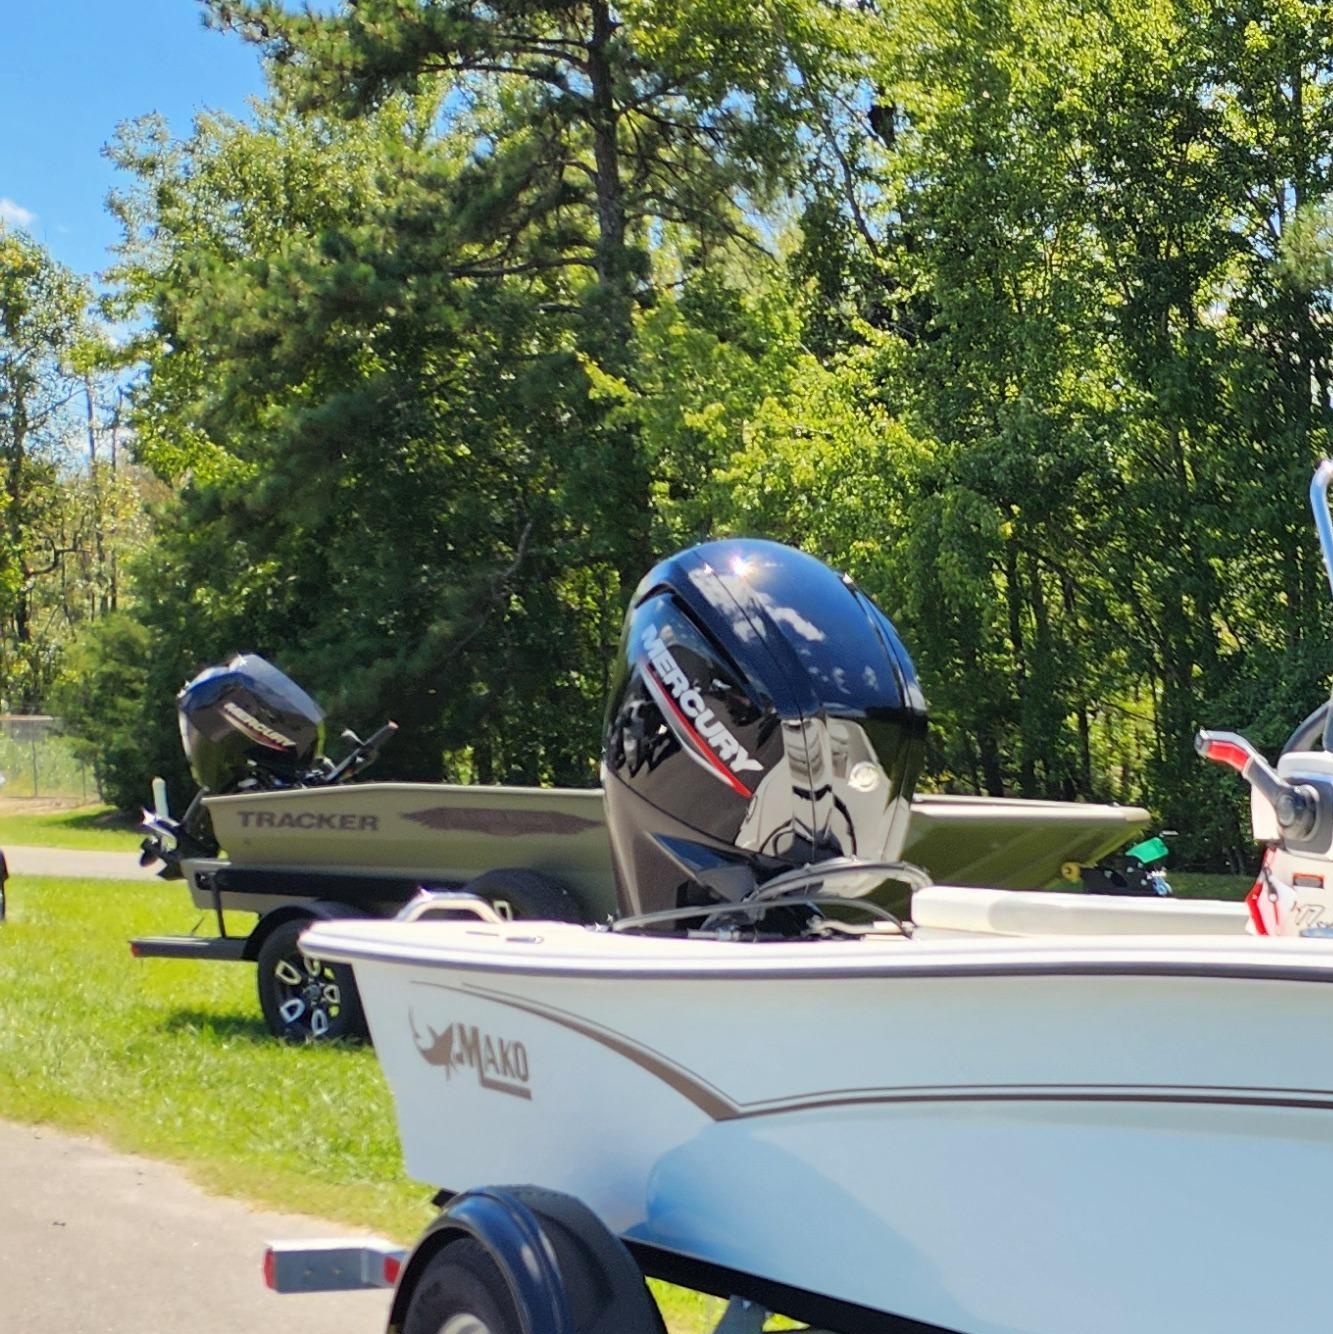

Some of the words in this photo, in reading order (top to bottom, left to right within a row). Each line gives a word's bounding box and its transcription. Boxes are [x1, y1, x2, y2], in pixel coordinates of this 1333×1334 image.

[223, 702, 297, 746] MERCURY
[642, 624, 765, 773] MERCURY
[238, 811, 379, 831] TRACKER
[453, 1022, 532, 1101] MAKO
